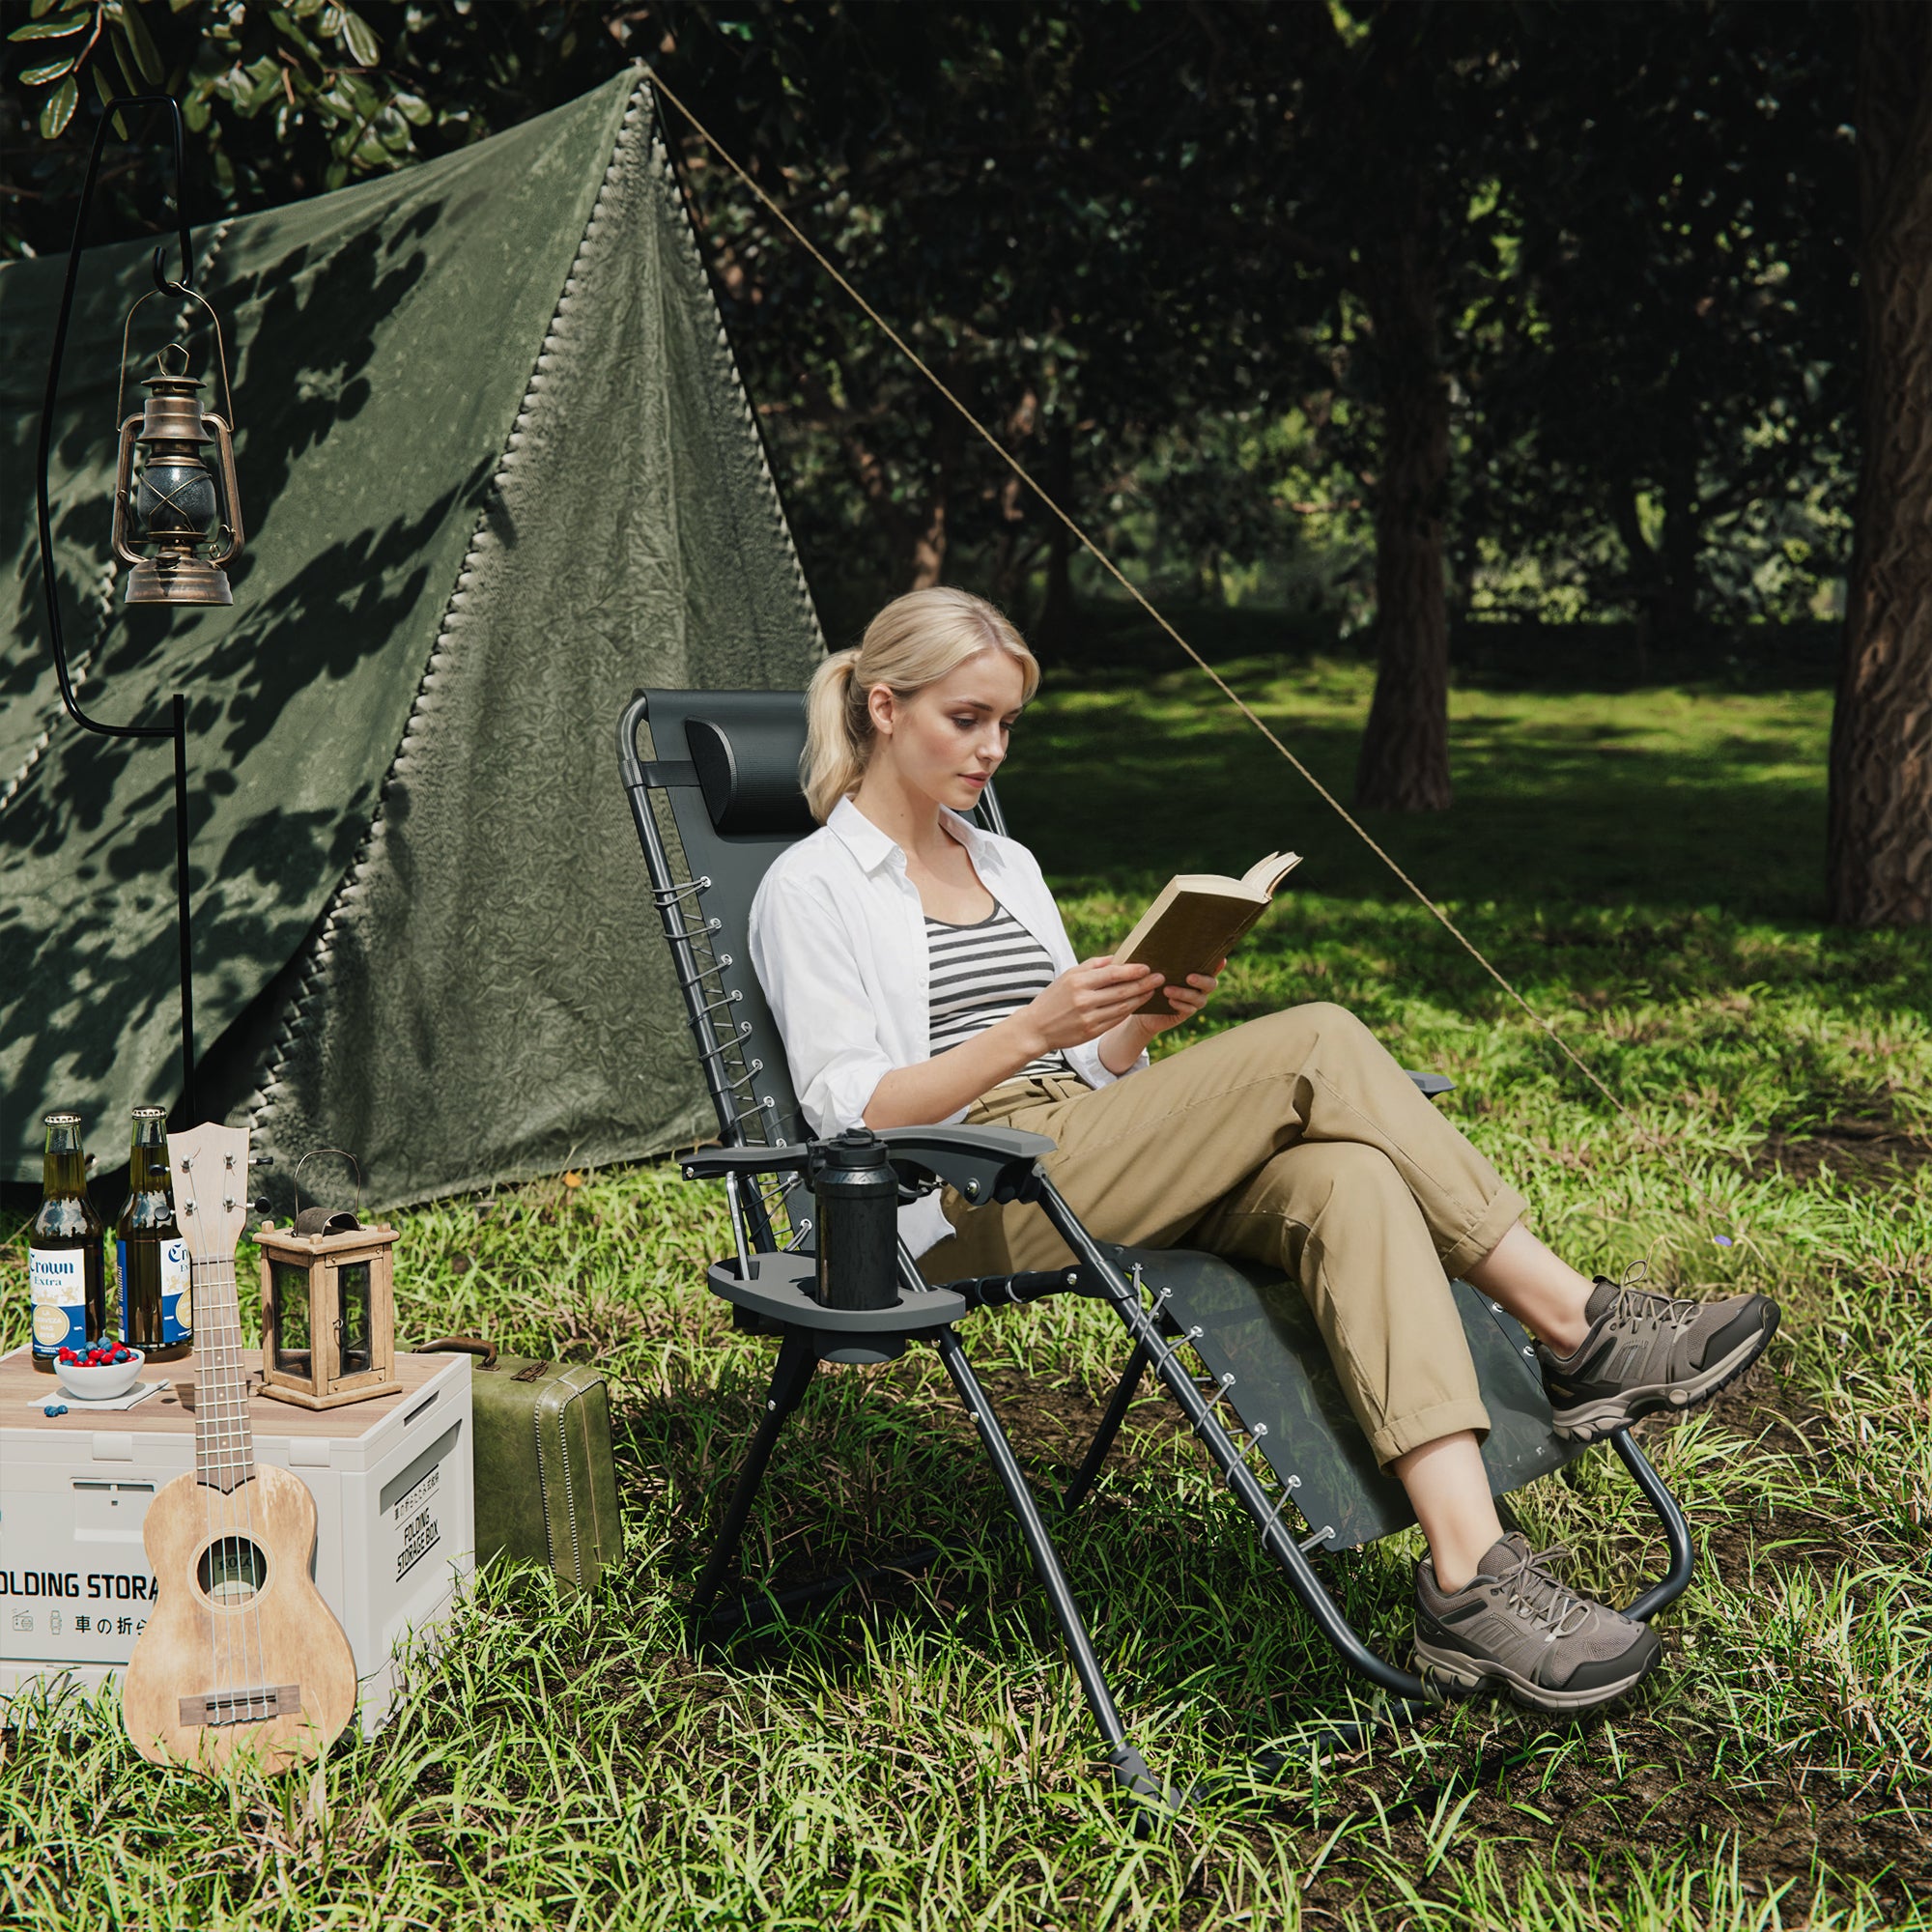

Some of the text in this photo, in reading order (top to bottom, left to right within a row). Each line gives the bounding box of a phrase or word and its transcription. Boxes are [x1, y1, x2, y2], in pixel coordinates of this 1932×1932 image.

[34, 1276, 63, 1287] Extra
[404, 1507, 430, 1546] FOLDING
[397, 1520, 439, 1574] STORAGE BOX
